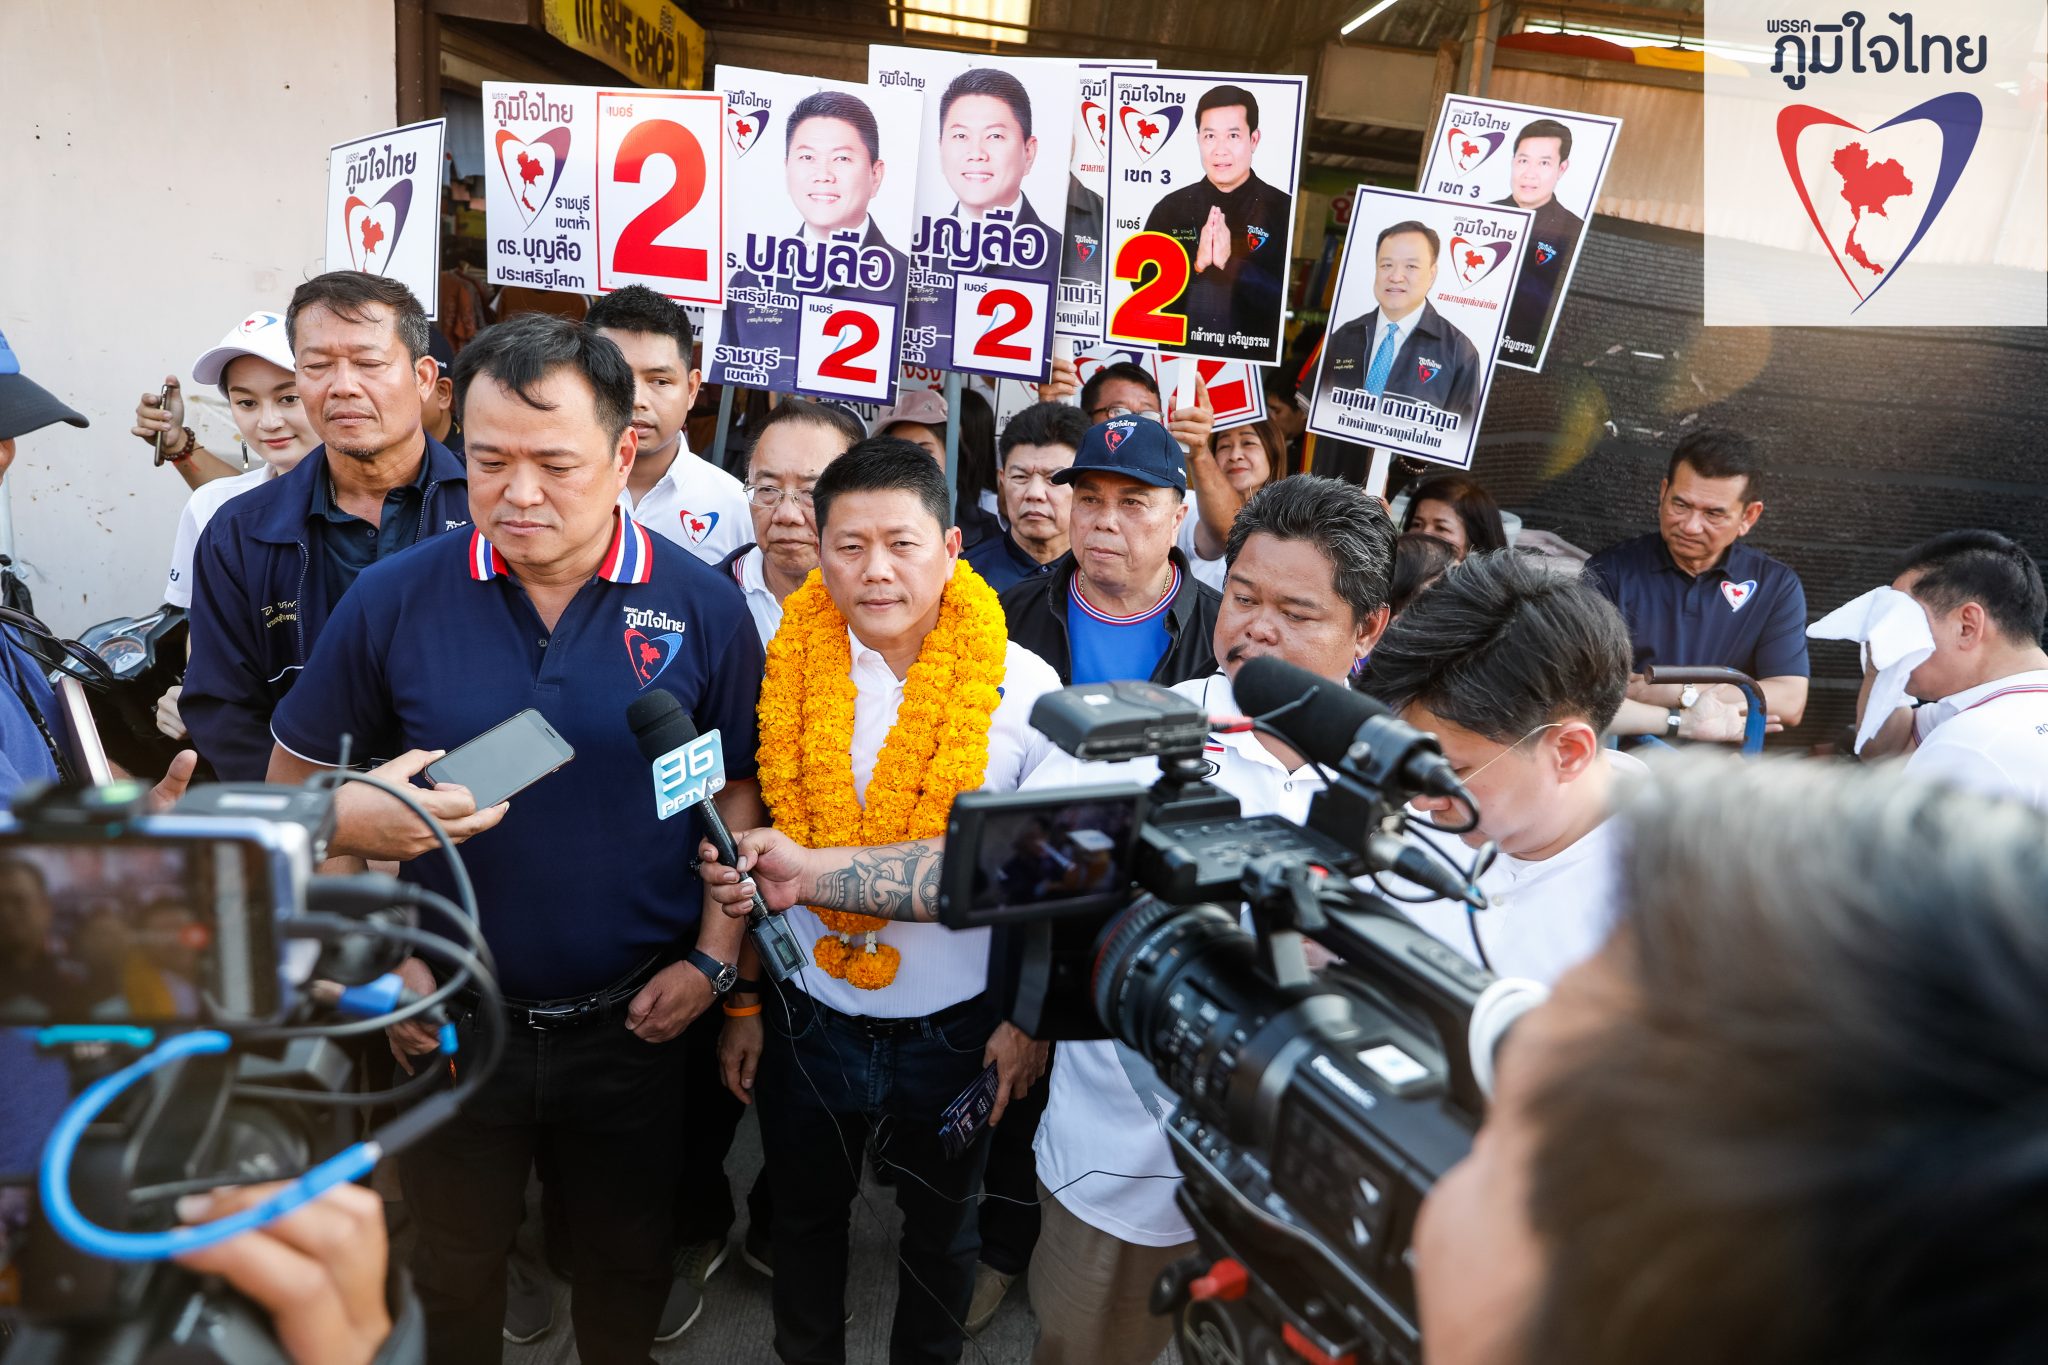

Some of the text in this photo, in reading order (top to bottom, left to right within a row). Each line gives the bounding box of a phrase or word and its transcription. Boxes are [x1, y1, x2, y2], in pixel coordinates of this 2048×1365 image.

[635, 15, 675, 90] SHOP
[879, 70, 926, 89] ภูมิใจไทย
[1119, 84, 1186, 106] ภูมิใจไทย
[494, 90, 573, 127] ภูมิใจไทย
[608, 104, 633, 117] เบอร์
[1451, 110, 1511, 131] ภูมิใจไทย
[345, 143, 417, 195] ภูมิใจไทย
[1124, 168, 1172, 185] เขต 3
[612, 118, 708, 282] 2
[1437, 181, 1481, 198] เขต 3
[555, 195, 591, 215] ราชบุรี
[555, 217, 591, 231] เขตห้า
[1116, 217, 1141, 230] เบอร์
[1453, 218, 1518, 241] ภูมิใจไทย
[523, 234, 582, 265] บุญลือ
[746, 231, 894, 290] บุญลือ
[496, 266, 586, 290] ประเสริฐโสภา
[963, 282, 988, 293] เบอร์
[1110, 231, 1190, 346] 2
[809, 303, 833, 314] เบอร์
[972, 288, 1034, 362] 2
[817, 310, 880, 384] 2
[1190, 327, 1270, 349] กล้าหาญ เจริญธรรม
[715, 346, 779, 370] ราชบุรี
[726, 367, 768, 385] เขตห้า
[1331, 388, 1460, 432] อนุทิน ชาญวีรกูล
[625, 609, 686, 633] ภูมิใจไทย
[660, 735, 714, 793] 36
[661, 777, 724, 817] PPTV HD
